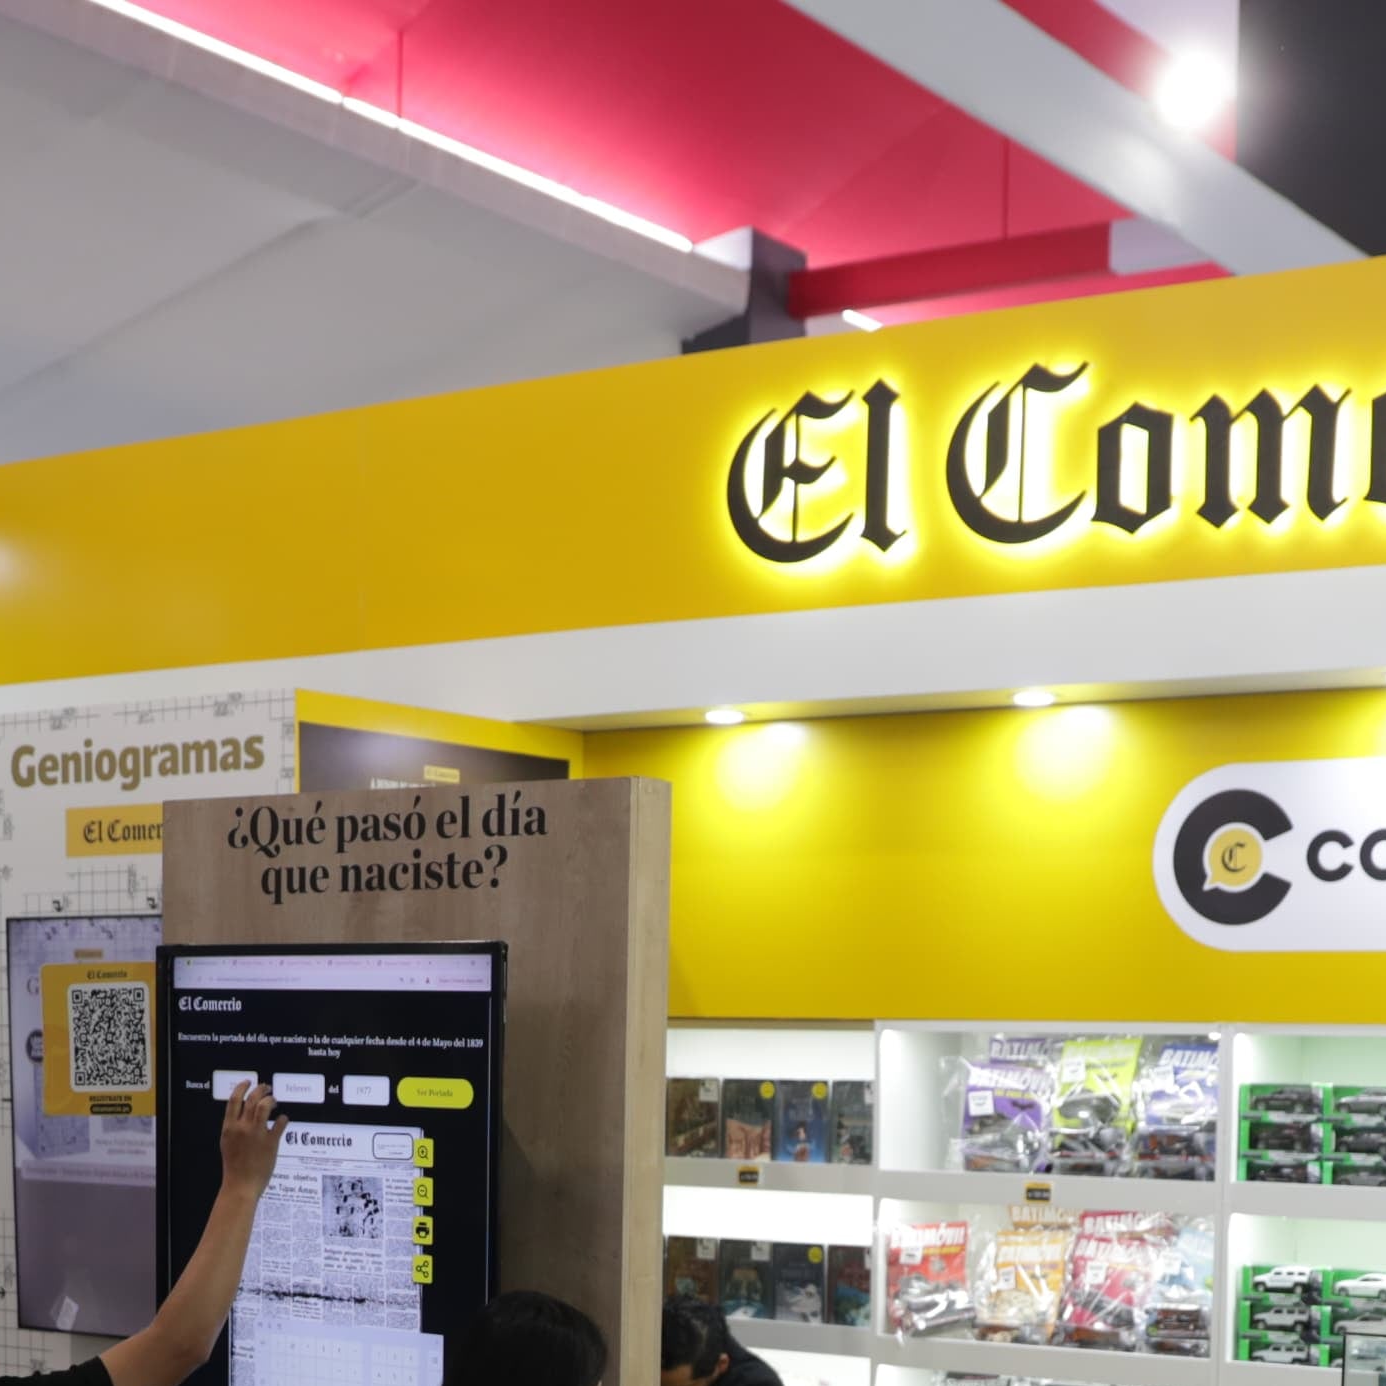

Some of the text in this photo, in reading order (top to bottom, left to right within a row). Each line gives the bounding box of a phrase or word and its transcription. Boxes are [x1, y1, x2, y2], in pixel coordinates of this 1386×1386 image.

[726, 377, 910, 564] El
[10, 733, 266, 791] Geniogramas
[82, 818, 104, 845] El
[227, 790, 548, 858] ¿Qué pasó el día
[259, 844, 509, 905] que naciste?
[179, 997, 243, 1012] El Comercio
[220, 1033, 245, 1045] portada
[246, 1033, 256, 1043] del
[269, 1036, 282, 1046] que
[284, 1034, 307, 1045] naciste
[321, 1034, 330, 1045] de
[331, 1034, 364, 1048] cualquier
[365, 1035, 385, 1046] fecha
[422, 1037, 431, 1048] de
[432, 1038, 453, 1050] Mayo
[454, 1037, 465, 1048] del
[308, 1046, 341, 1060] hasta hoy
[285, 1131, 353, 1148] El Comercio
